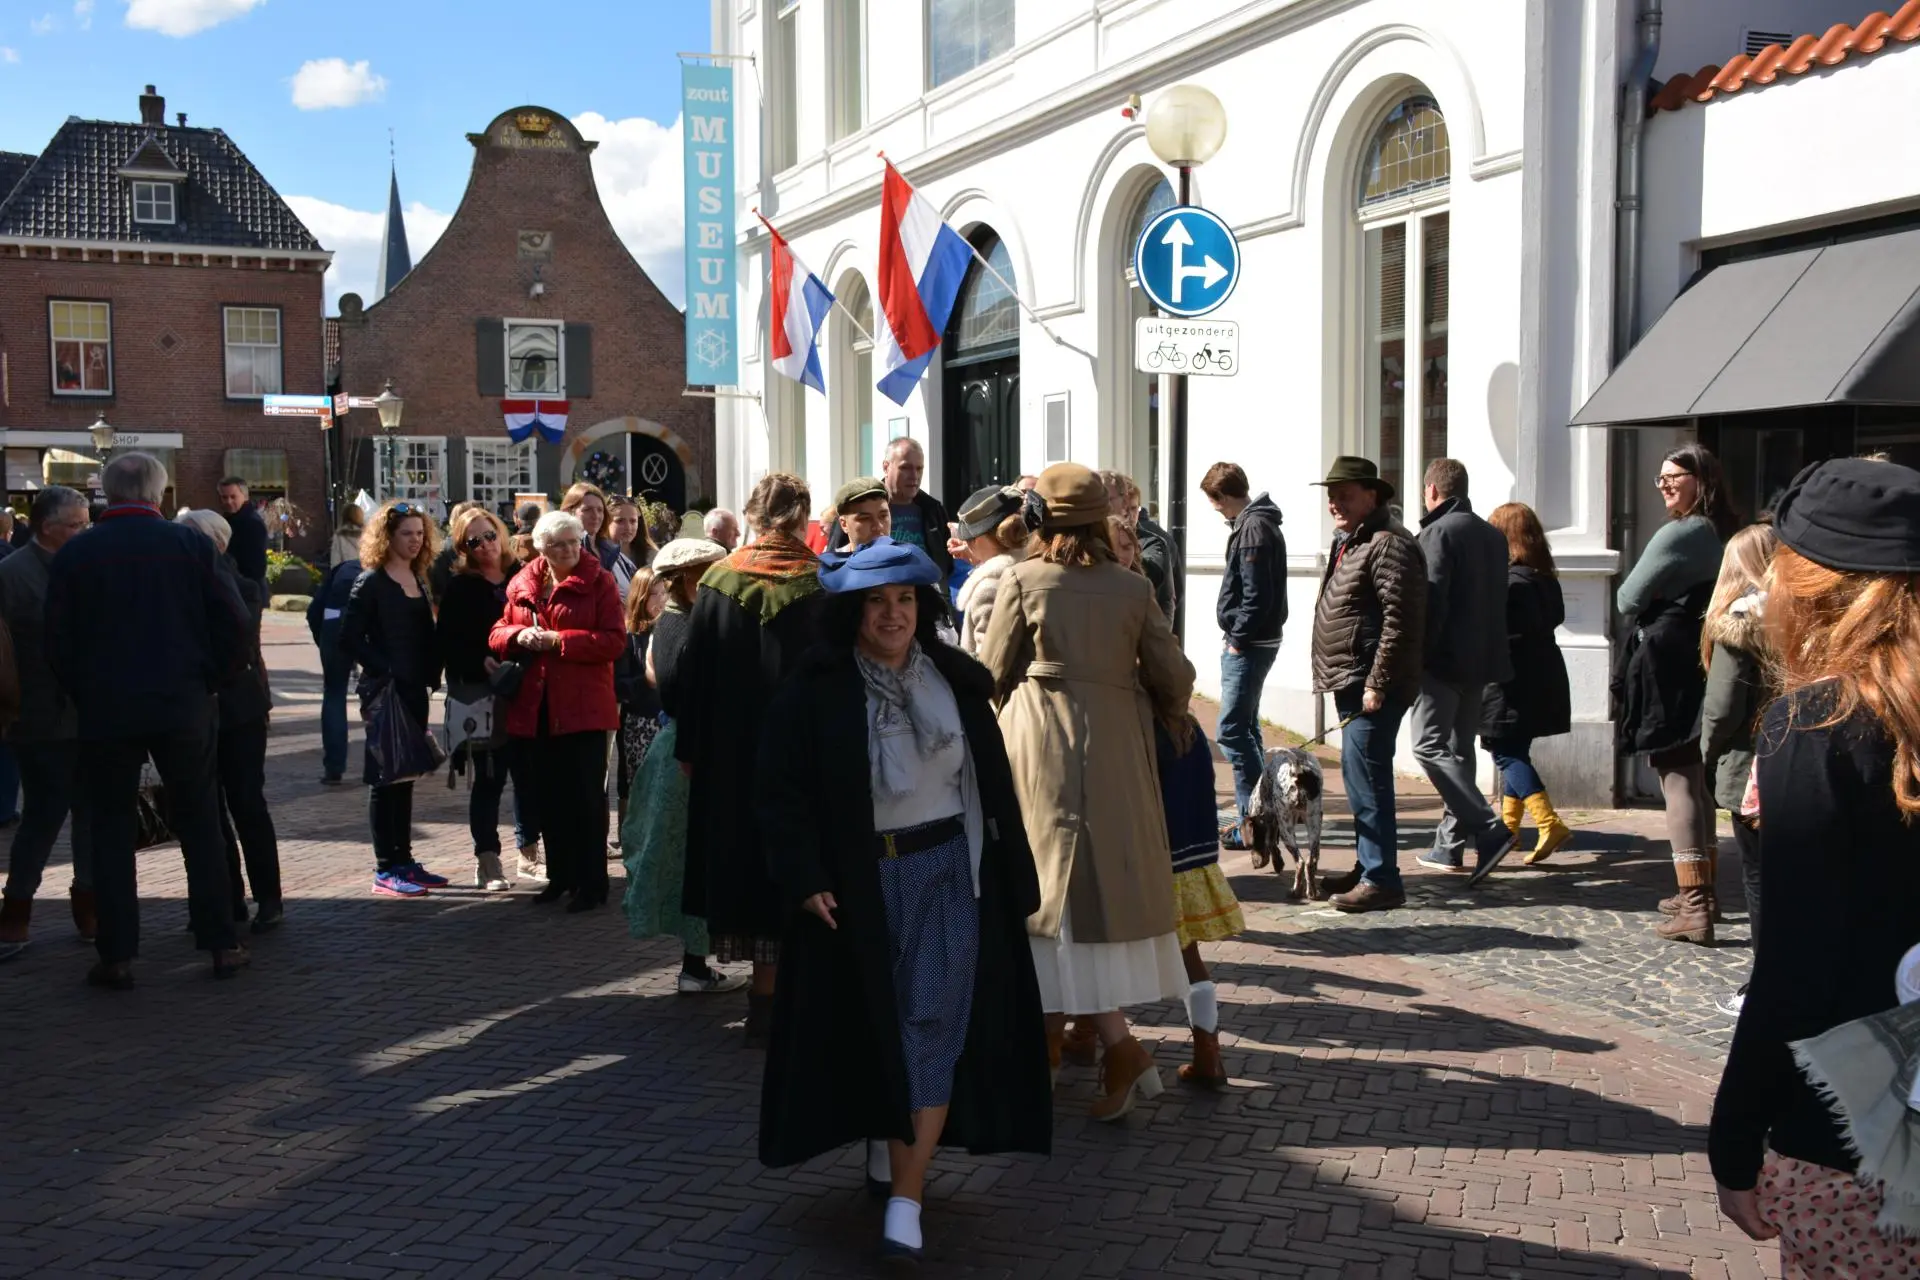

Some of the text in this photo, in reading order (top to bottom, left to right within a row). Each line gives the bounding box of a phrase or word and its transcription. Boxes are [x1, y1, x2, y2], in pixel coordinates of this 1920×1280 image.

[686, 86, 729, 103] zout
[691, 115, 730, 319] MUSEUM
[1147, 324, 1233, 337] uitgezonderd
